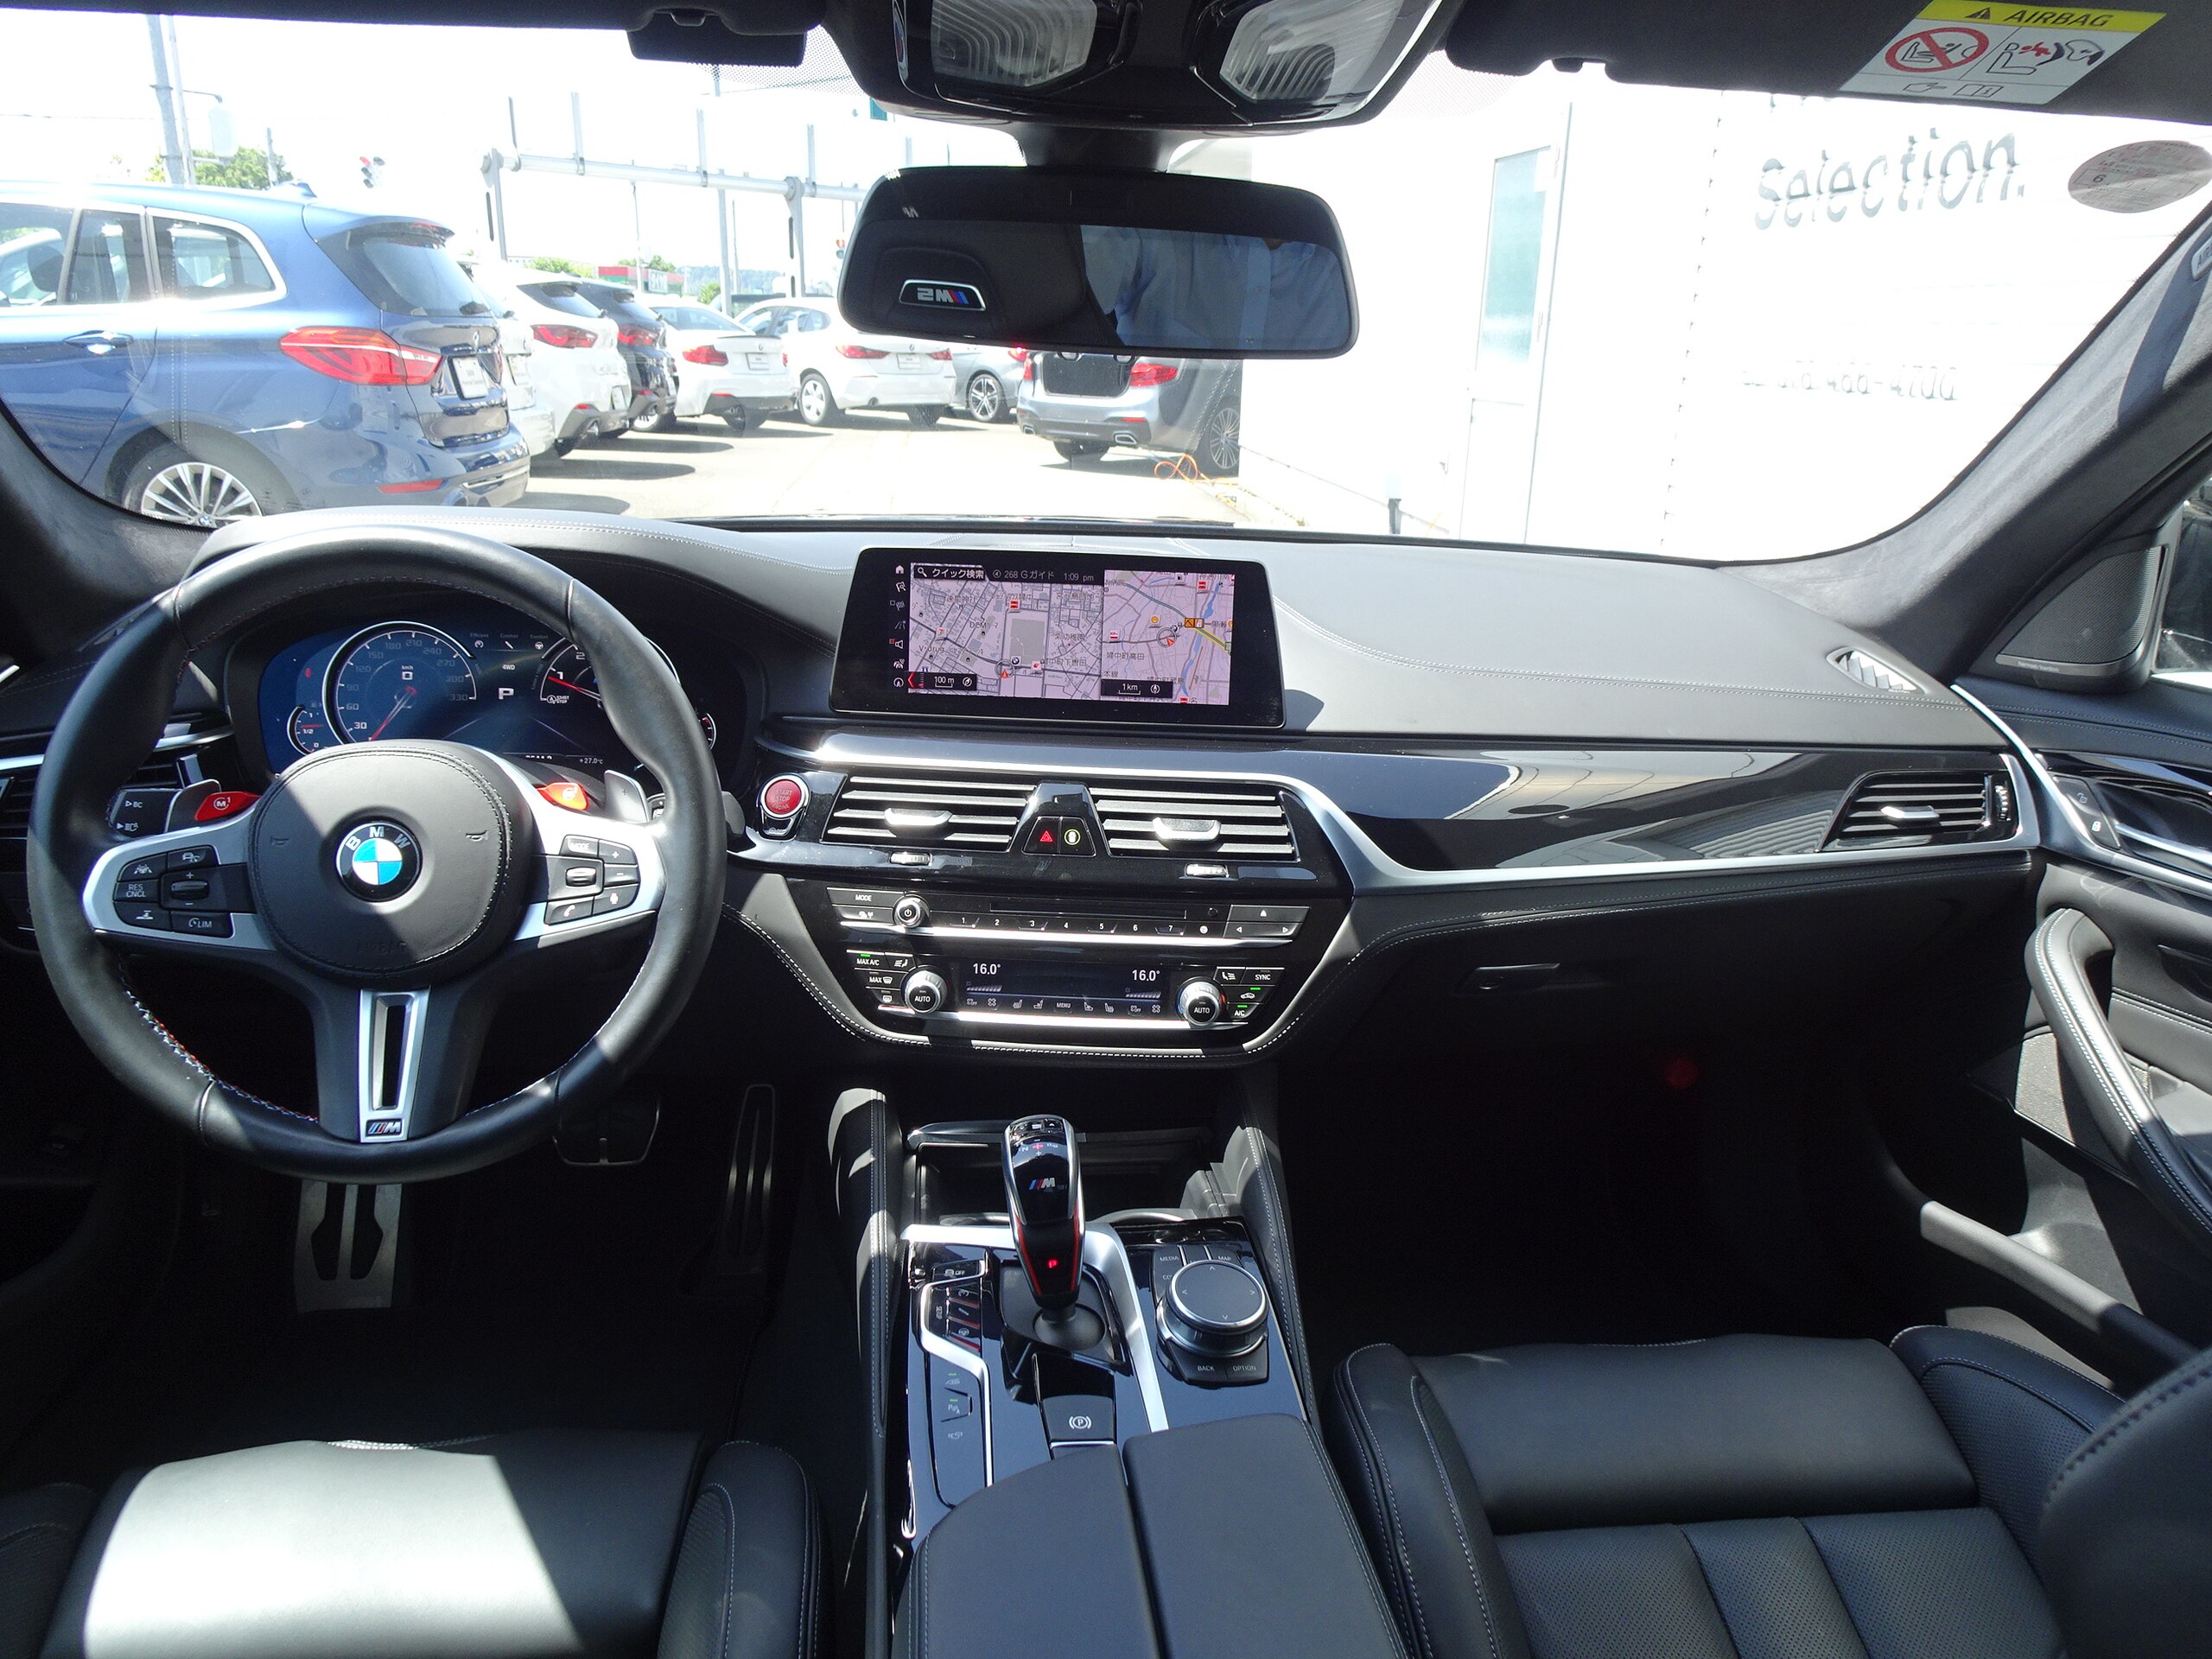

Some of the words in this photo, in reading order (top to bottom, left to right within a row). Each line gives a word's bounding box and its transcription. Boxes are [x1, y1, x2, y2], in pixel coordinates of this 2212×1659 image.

[2003, 9, 2114, 28] AIRBAG
[931, 568, 985, 580] クイック検索
[1004, 570, 1019, 579] 268
[1064, 572, 1080, 581] 1:09
[575, 652, 586, 660] 2
[934, 676, 949, 684] 100
[499, 688, 514, 700] P
[346, 826, 410, 851] BMW
[855, 893, 873, 902] MODE
[198, 919, 213, 928] LIM
[995, 918, 1001, 927] 2
[1029, 918, 1035, 927] 3
[1064, 921, 1070, 930] 4
[1099, 922, 1105, 931] 5
[1133, 924, 1139, 932] 6
[856, 957, 870, 966] MAX
[868, 976, 882, 984] MAX
[1255, 972, 1272, 982] SYNC
[1193, 1006, 1211, 1014] AUTO
[1048, 1259, 1058, 1268] P
